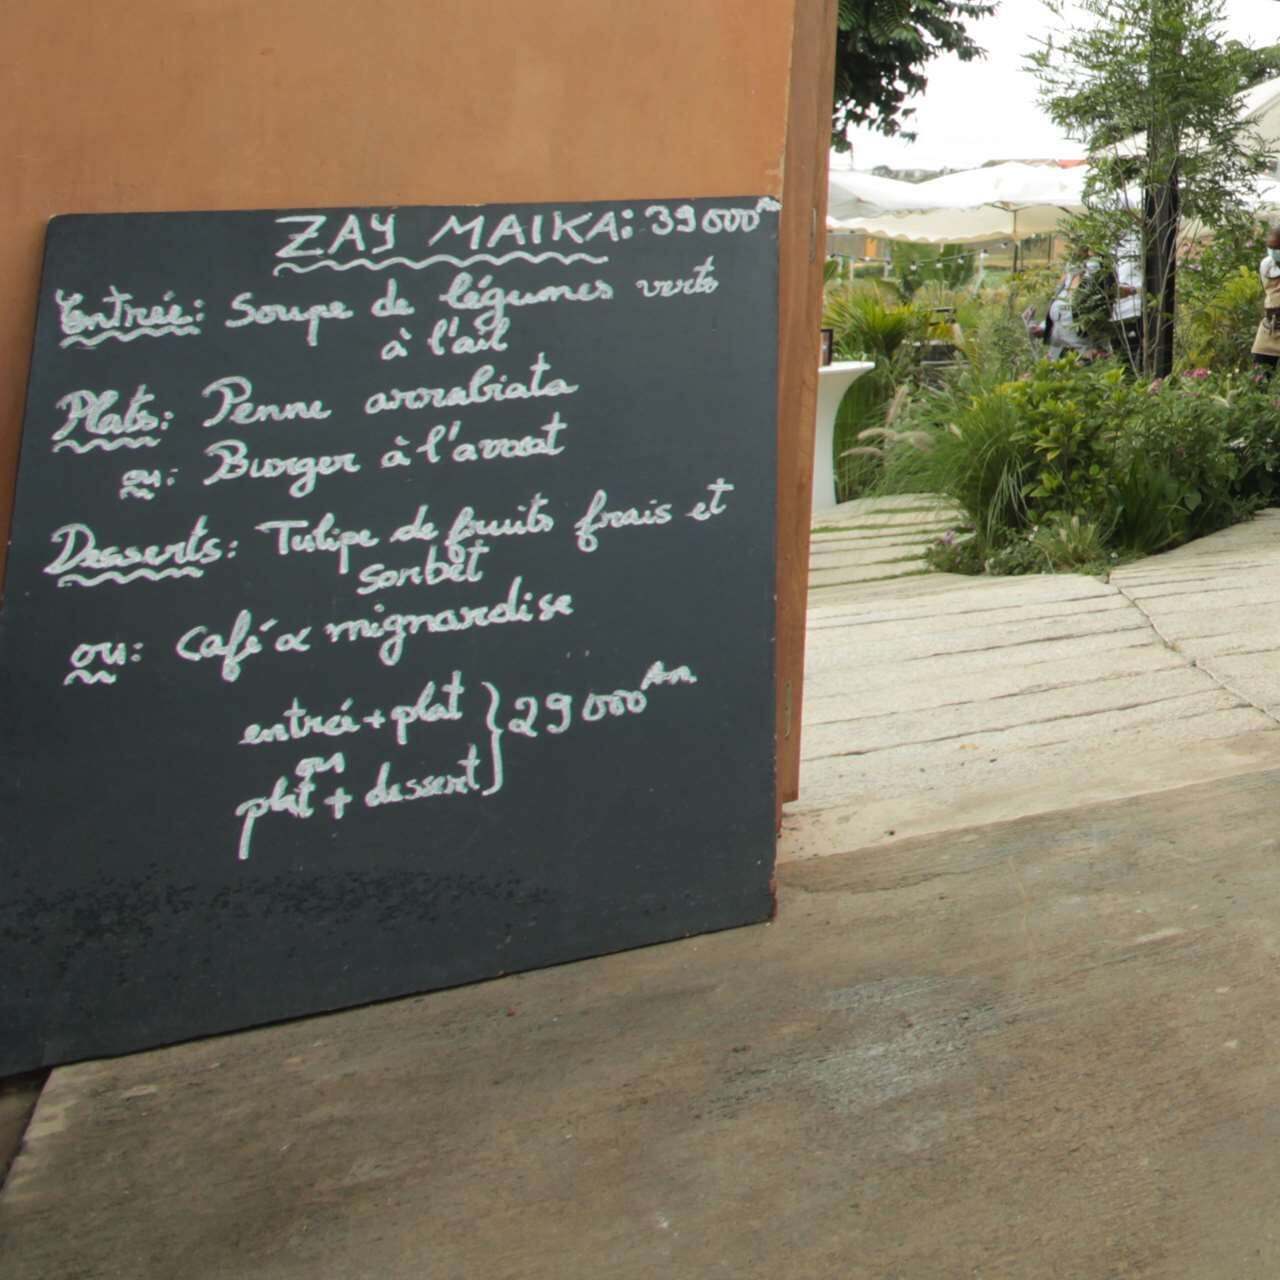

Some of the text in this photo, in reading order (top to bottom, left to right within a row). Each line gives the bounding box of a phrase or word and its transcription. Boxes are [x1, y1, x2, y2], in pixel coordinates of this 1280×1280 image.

[274, 214, 397, 259] ZAY
[225, 291, 354, 347] Soupe
[371, 278, 415, 317] de
[439, 271, 614, 336] légumes
[636, 256, 719, 298] verts
[381, 317, 510, 361] à l'ail
[201, 376, 332, 428] Penne
[201, 439, 360, 498] Burger
[43, 478, 735, 575] Desserts: Tulipe de fruits frais et
[70, 642, 144, 669] ou:
[175, 609, 278, 682] Café
[323, 576, 574, 667] mignardise
[390, 670, 466, 746] plat
[234, 775, 317, 862] plat
[364, 743, 482, 808] dessert
